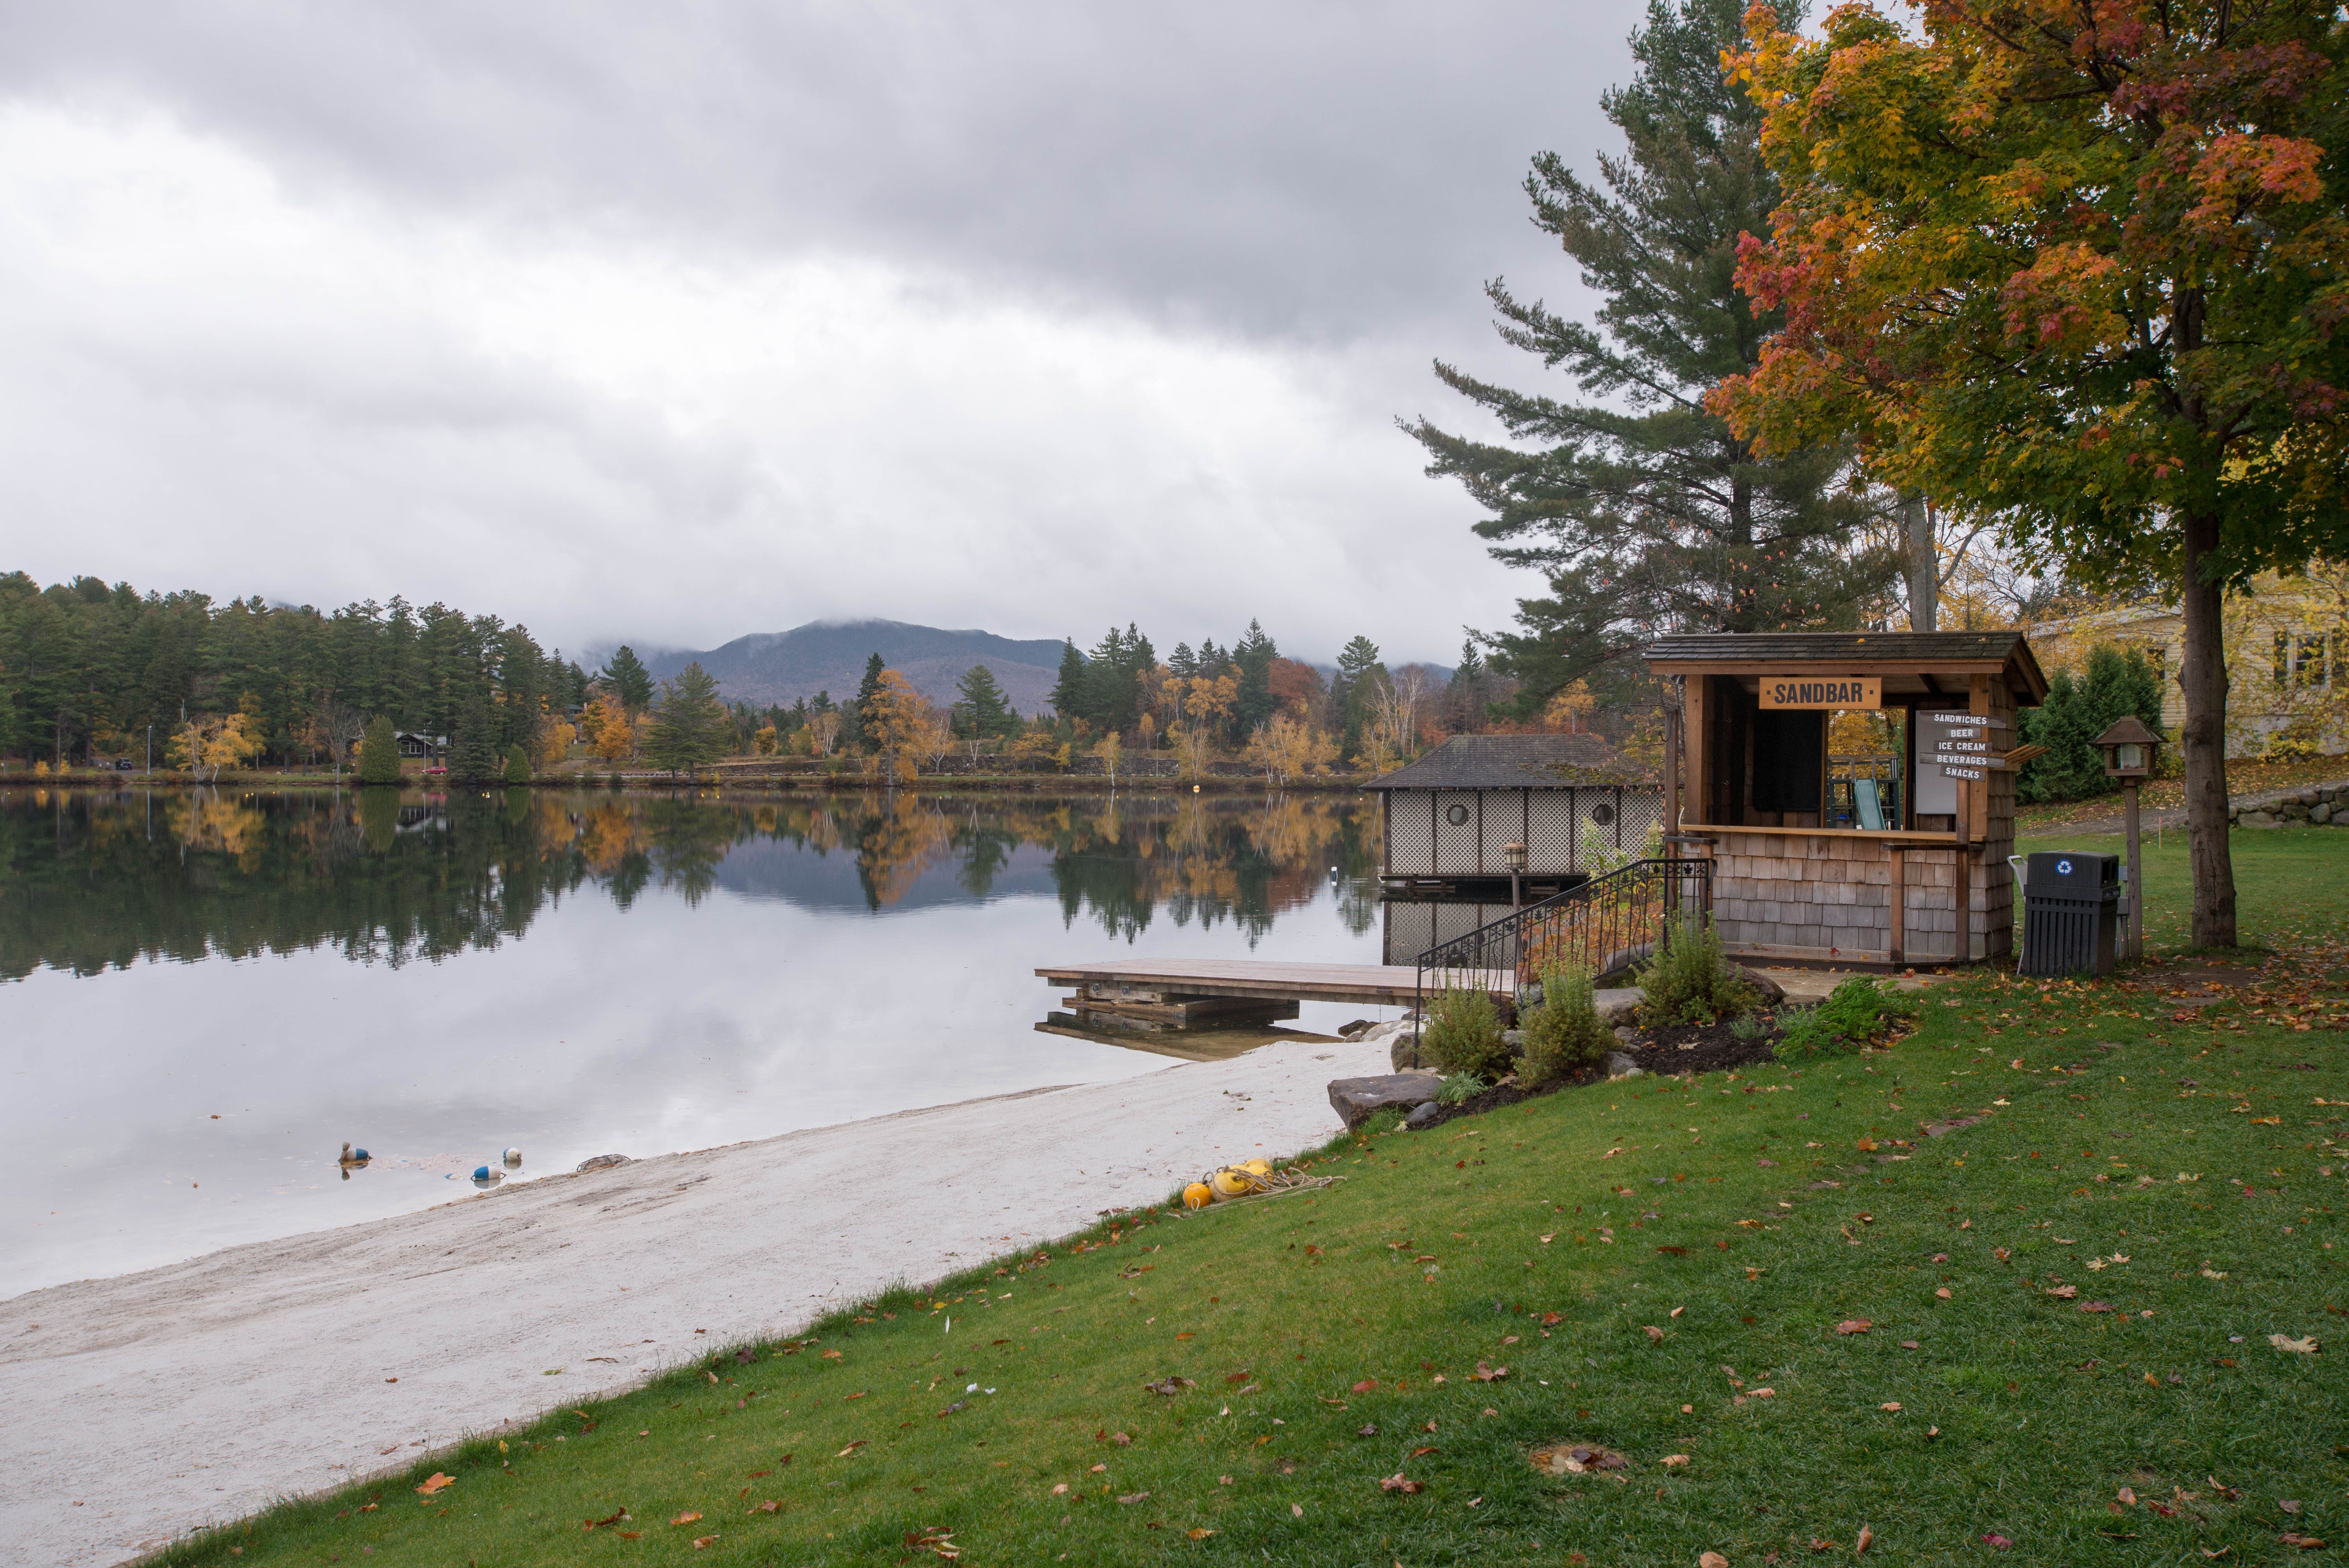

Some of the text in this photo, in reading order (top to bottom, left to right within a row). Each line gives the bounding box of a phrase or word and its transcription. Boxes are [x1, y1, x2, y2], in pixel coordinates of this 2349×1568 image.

[1775, 682, 1862, 704] SANDBAR
[1934, 714, 1987, 724] SANDWICHES
[1957, 742, 1985, 751] CREAM
[1937, 755, 1987, 764] BEVERAGES
[1946, 767, 1979, 779] SNACKS
